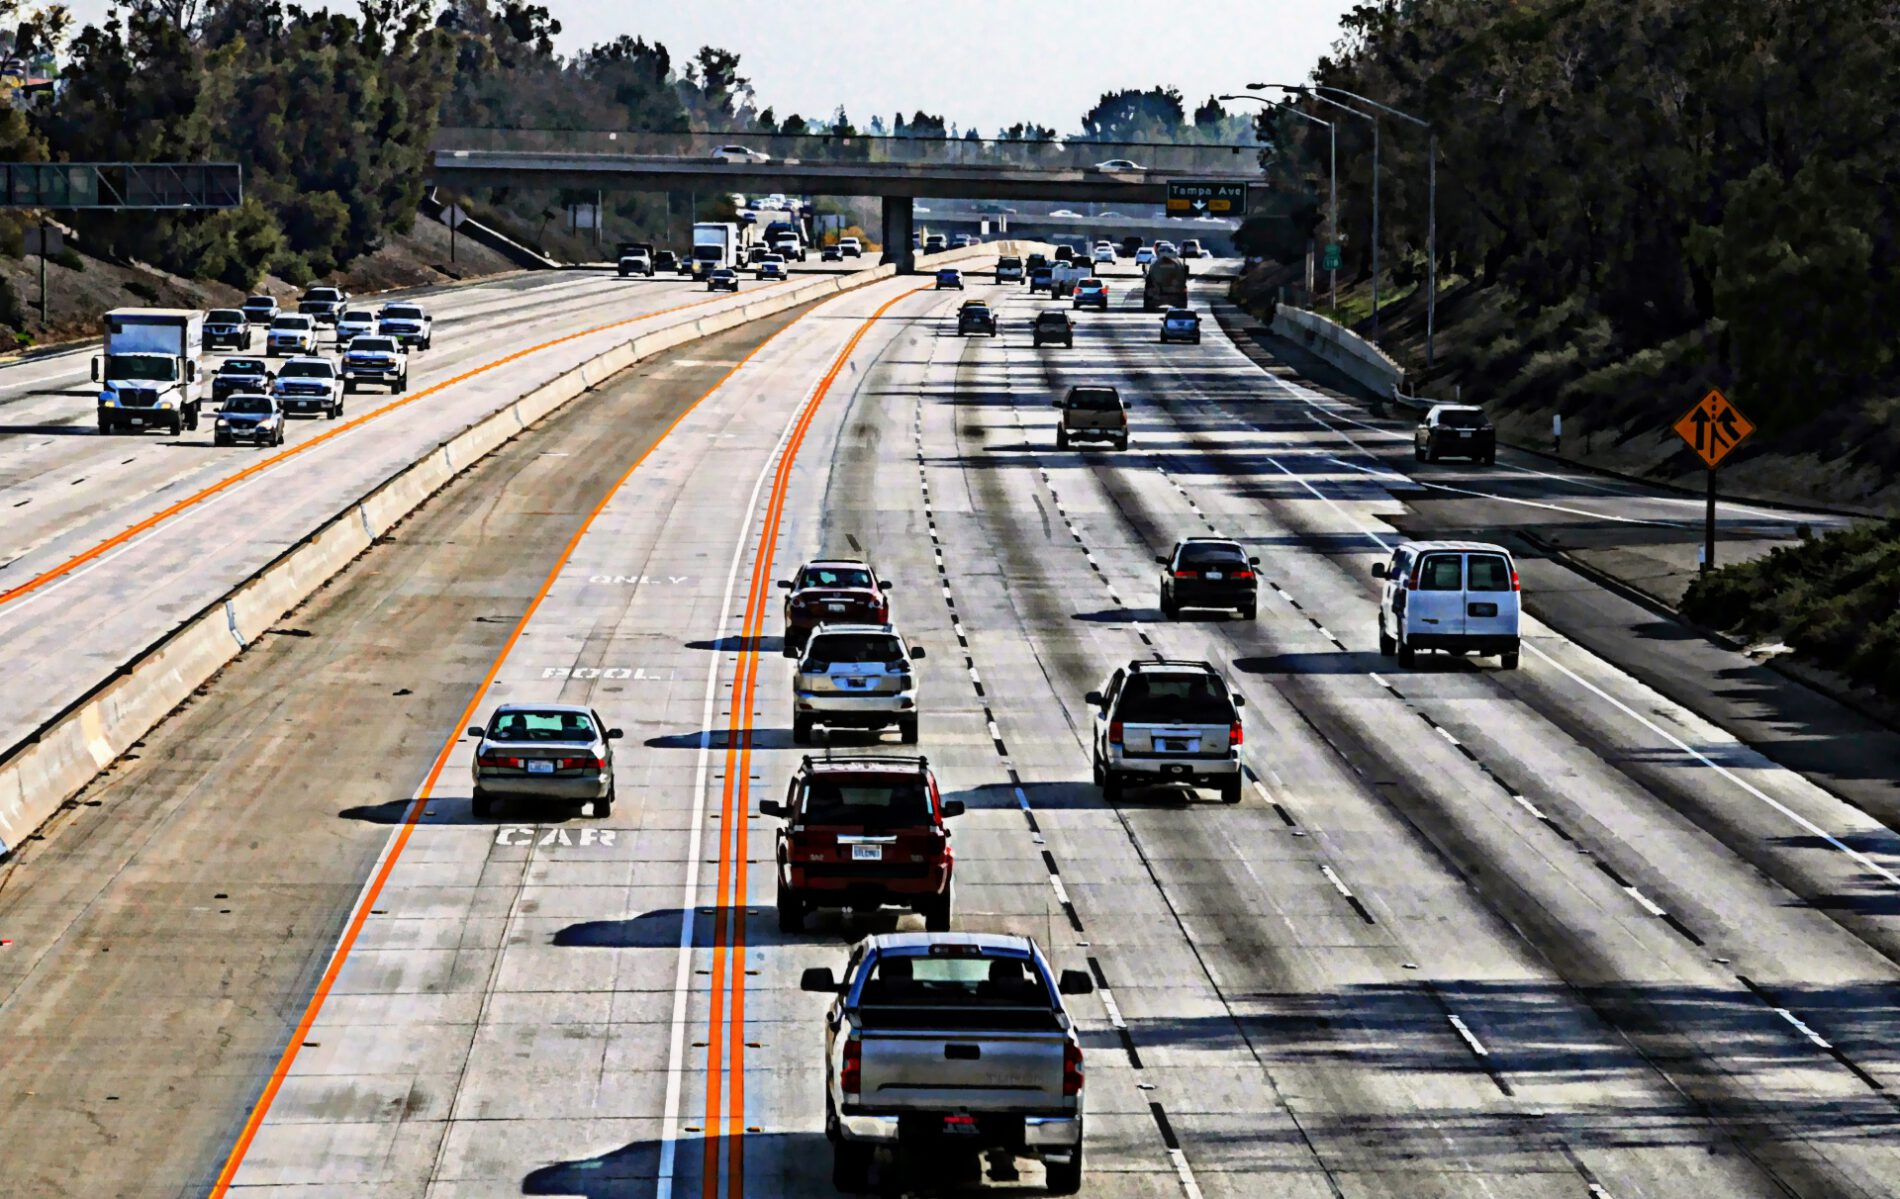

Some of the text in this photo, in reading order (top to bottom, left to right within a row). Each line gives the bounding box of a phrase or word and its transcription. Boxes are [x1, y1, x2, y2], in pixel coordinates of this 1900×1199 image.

[1172, 185, 1242, 196] Tampa Ave
[588, 575, 689, 584] ONLY
[541, 667, 662, 680] POOL
[495, 828, 616, 847] CAR
